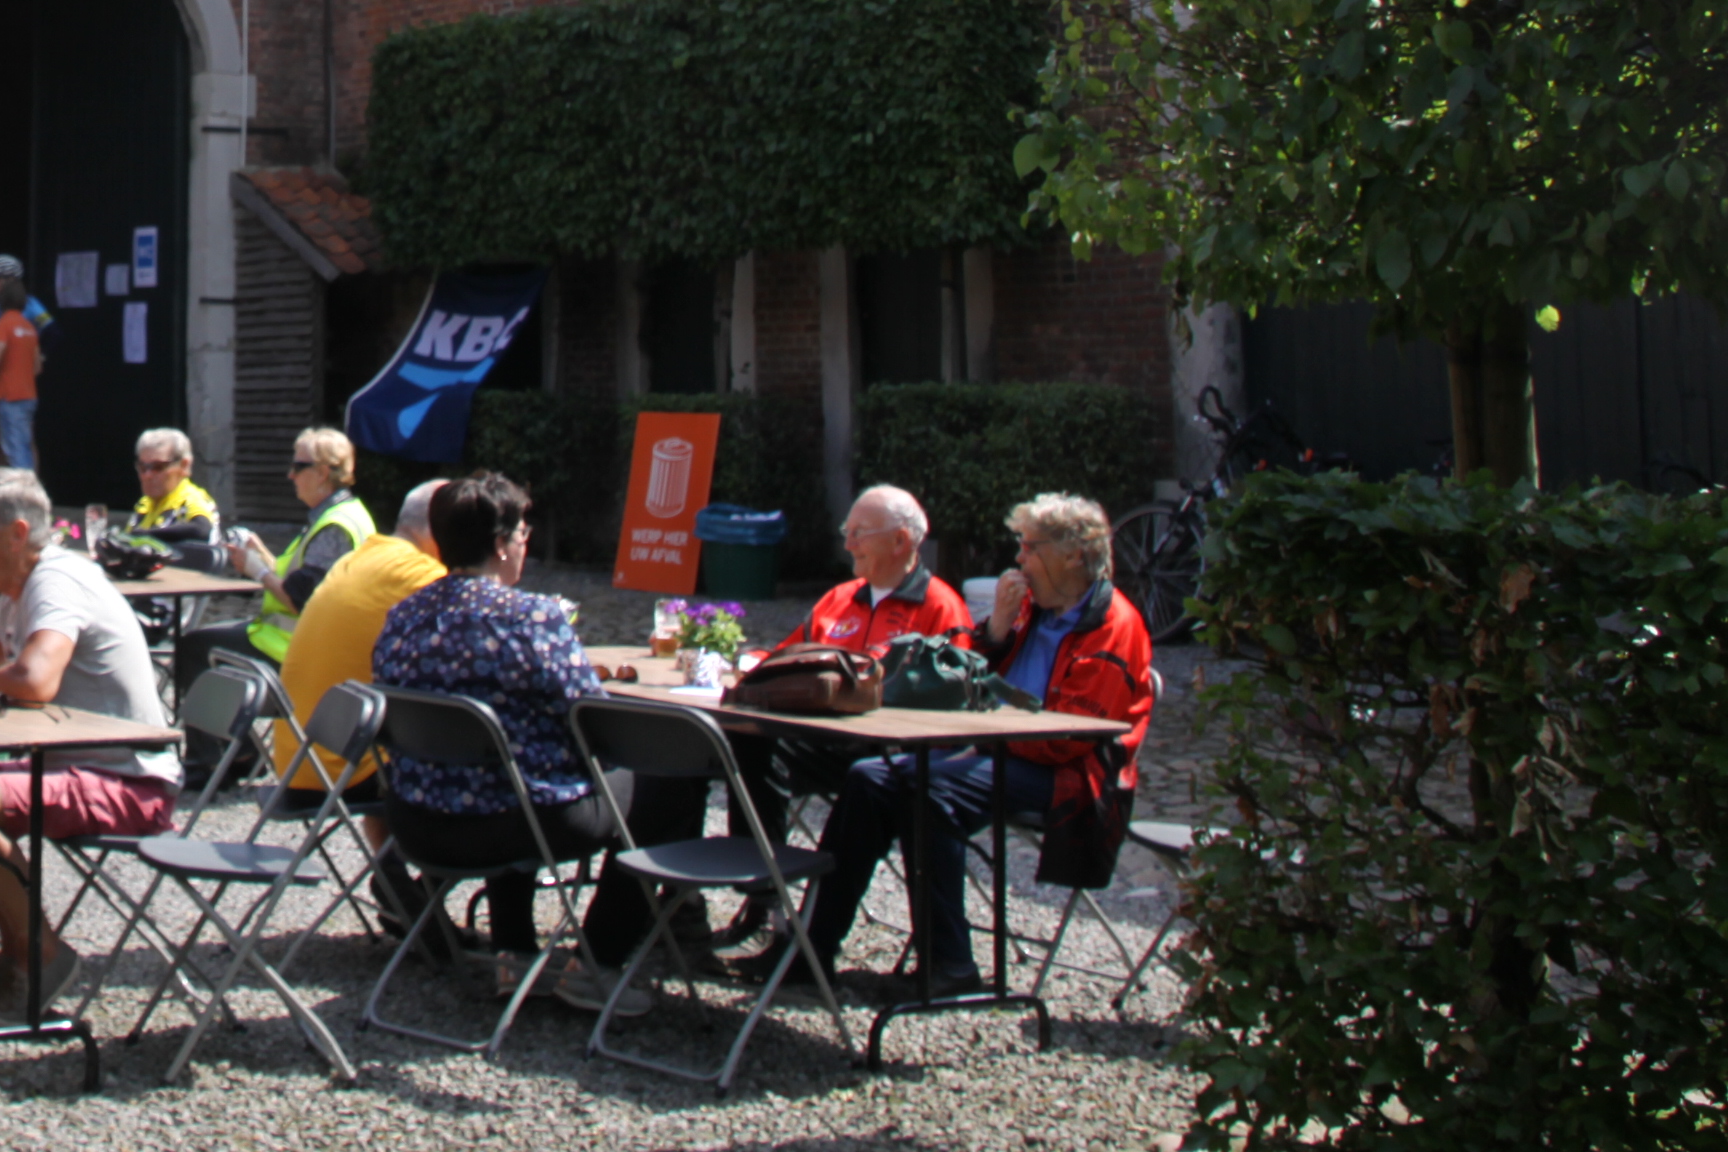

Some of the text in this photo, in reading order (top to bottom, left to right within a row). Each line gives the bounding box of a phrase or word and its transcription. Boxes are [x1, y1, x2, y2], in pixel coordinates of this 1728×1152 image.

[631, 529, 688, 547] WERP HIER
[630, 547, 682, 565] UW AFVAL
